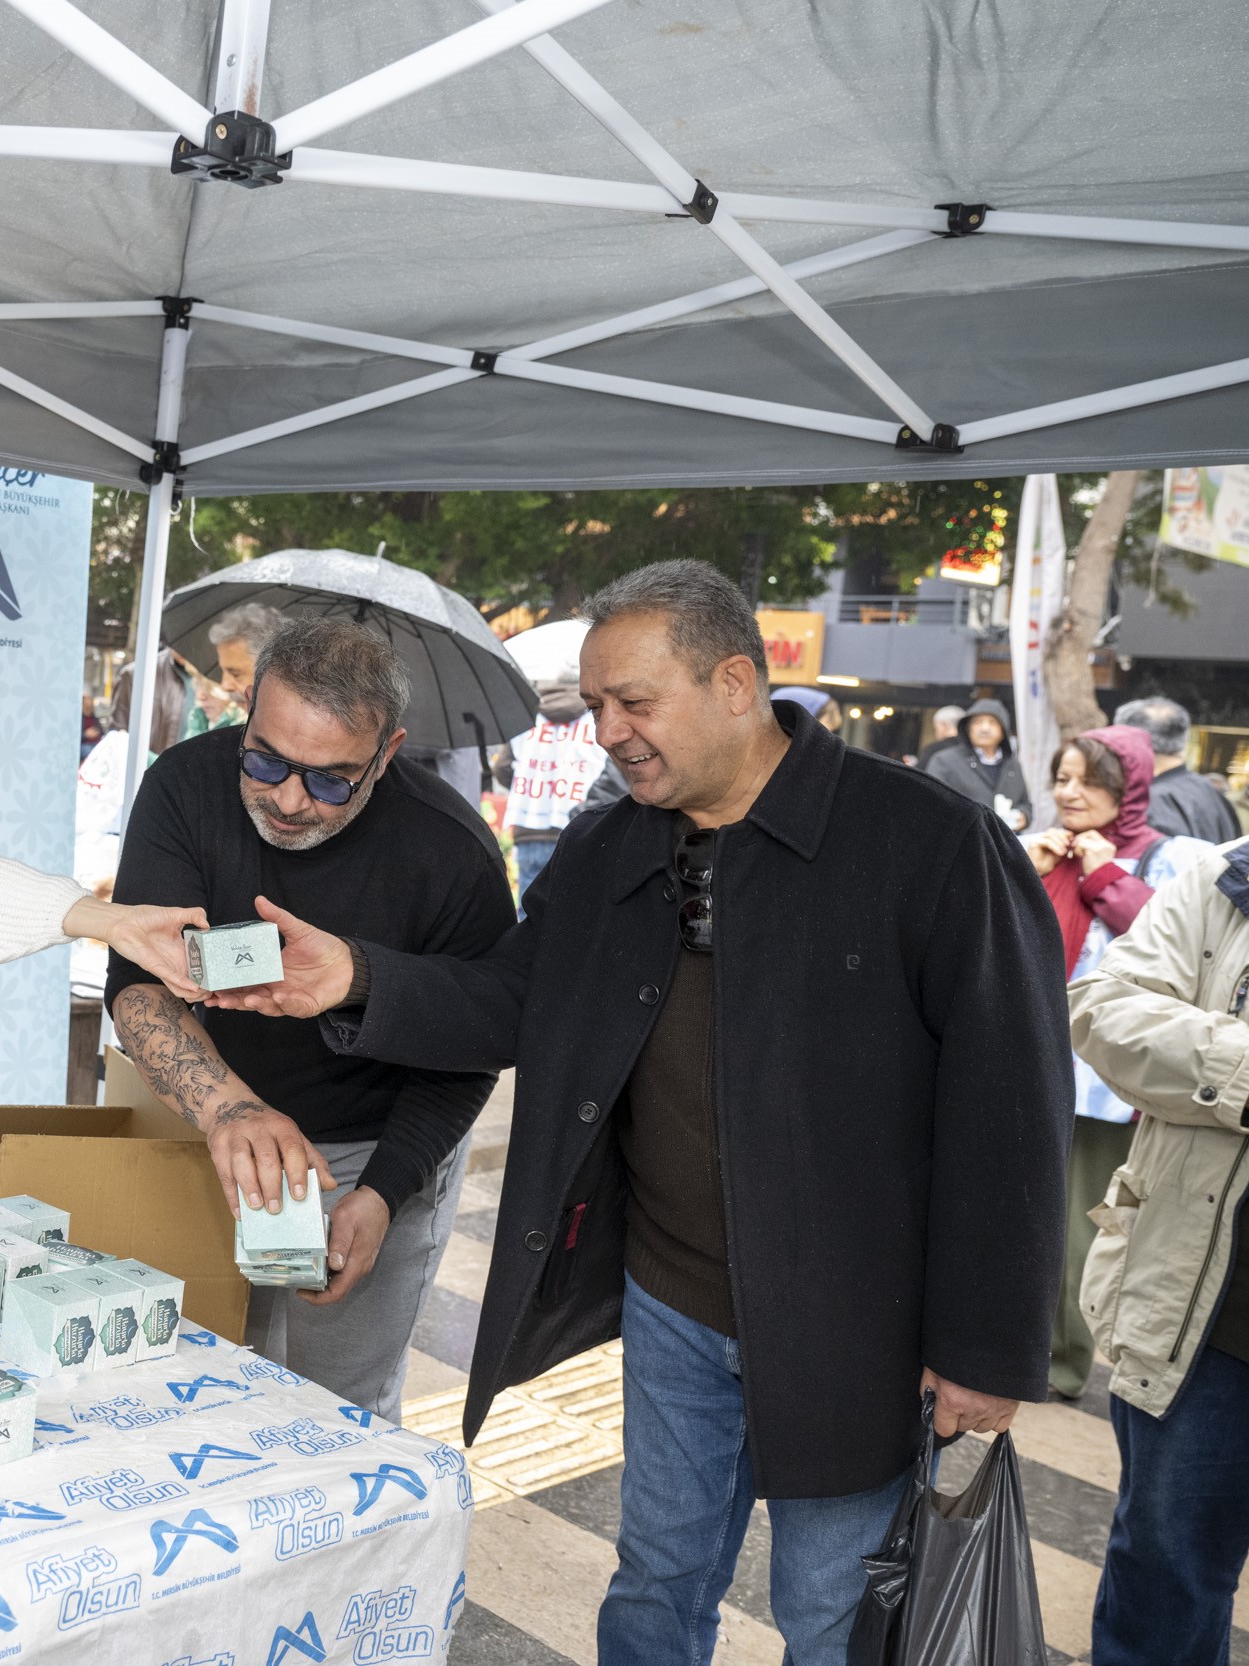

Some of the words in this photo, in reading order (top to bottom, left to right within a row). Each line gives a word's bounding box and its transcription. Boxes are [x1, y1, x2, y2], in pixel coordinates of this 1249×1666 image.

[3, 489, 61, 509] BÜYÜKŞEHİR
[108, 1405, 185, 1429] Olsun
[292, 1429, 363, 1456] Olsun
[62, 1469, 141, 1504] Afiyet
[102, 1482, 186, 1510] Olsun
[251, 1486, 323, 1526] Afiyet
[402, 1509, 430, 1523] BELEDİYESİ
[277, 1514, 342, 1558] Olsun
[29, 1548, 114, 1593] Afiyet
[160, 1583, 182, 1596] MERSİN
[180, 1573, 216, 1589] BÜYÜKŞEHİR
[214, 1564, 243, 1580] BELEDİYESİ
[60, 1577, 139, 1627] Olsun
[341, 1589, 415, 1636] Afiyet
[355, 1627, 430, 1664] Olsun
